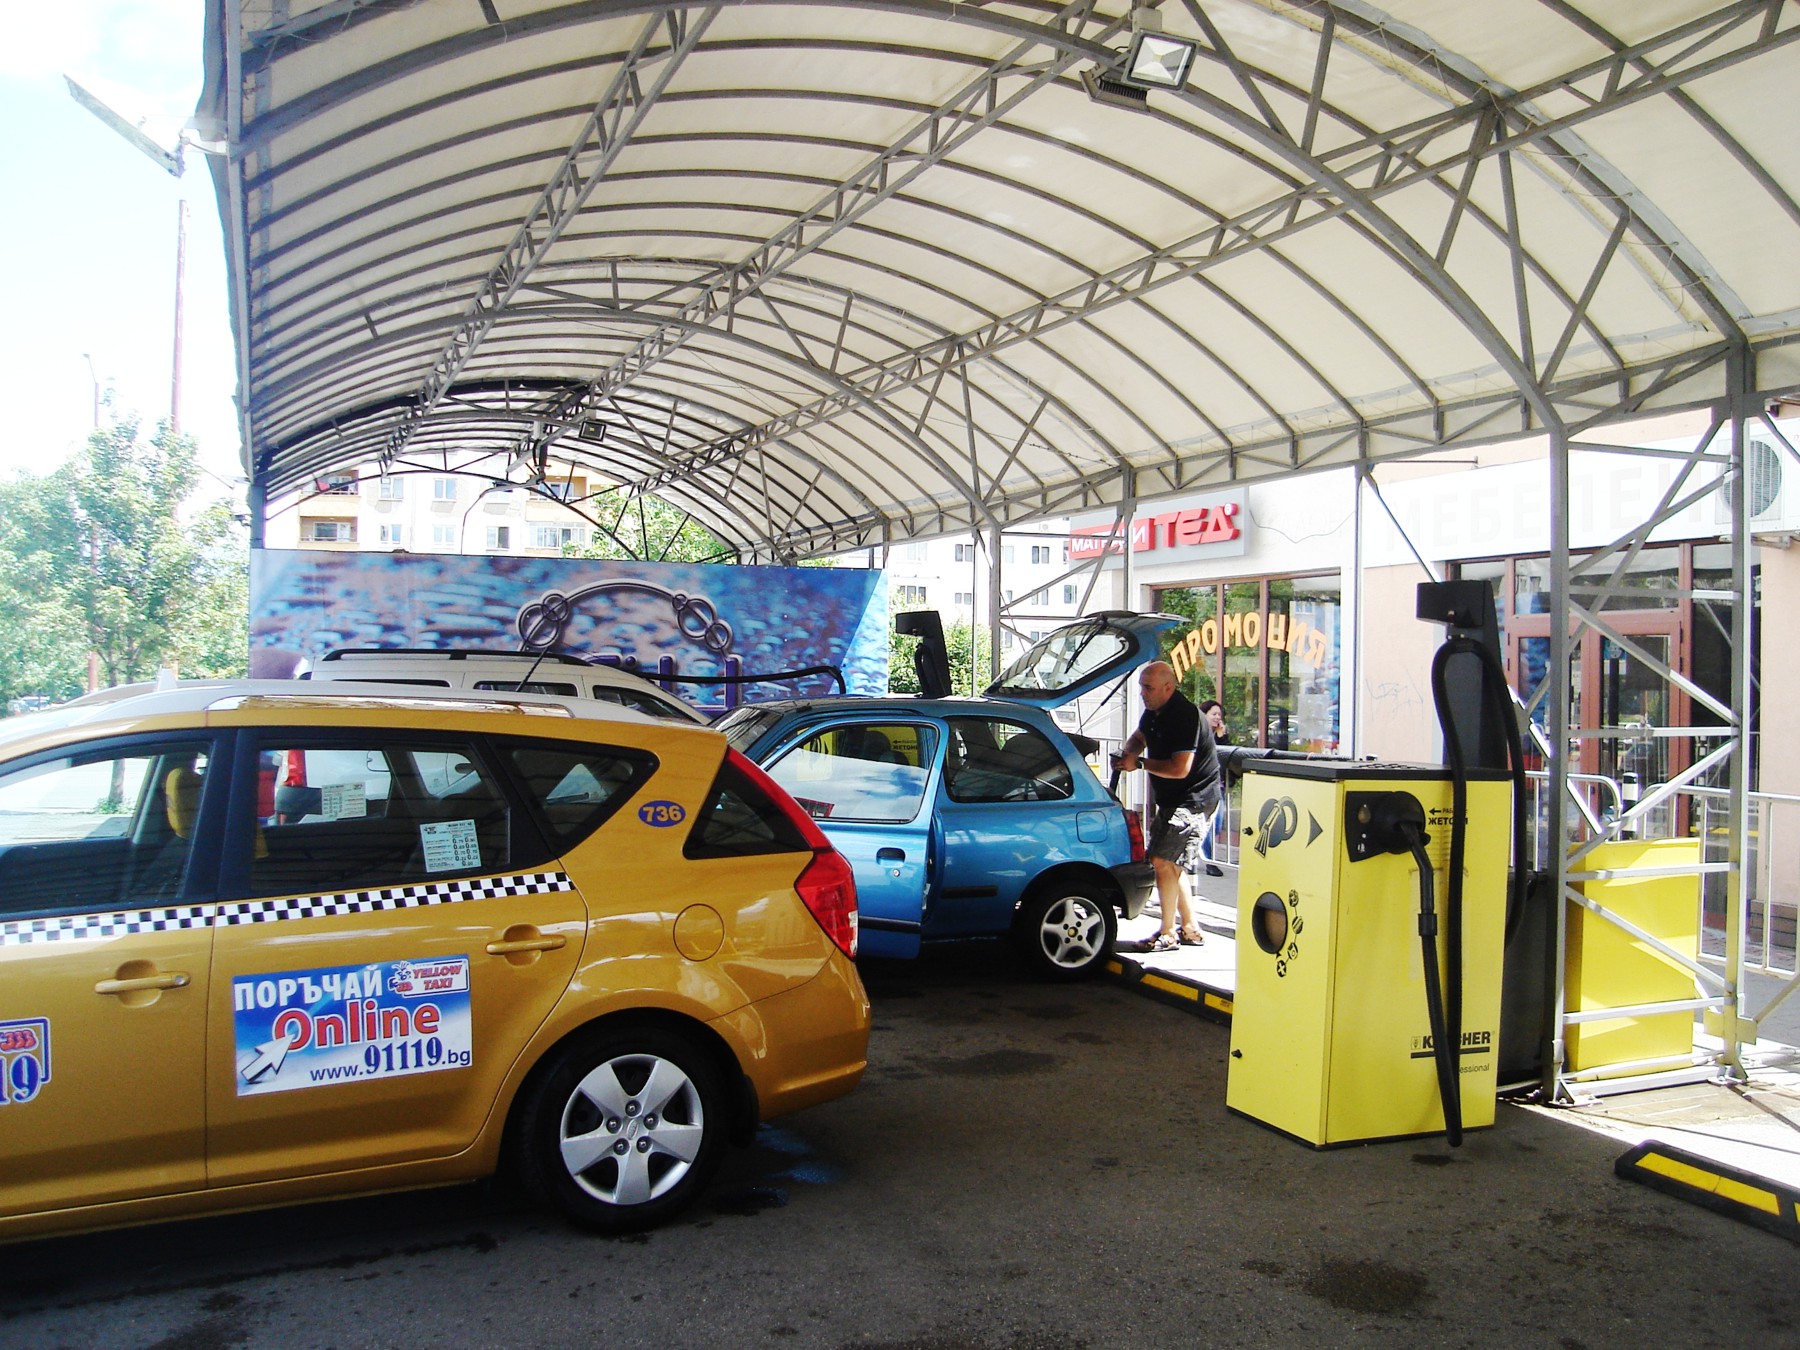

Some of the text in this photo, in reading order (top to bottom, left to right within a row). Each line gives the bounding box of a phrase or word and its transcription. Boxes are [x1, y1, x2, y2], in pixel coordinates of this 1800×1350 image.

[1153, 505, 1241, 548] ТЕД
[1170, 611, 1328, 684] ПРОМОЦИЯ
[642, 805, 682, 822] 736
[235, 965, 382, 1011] ПОРЪЧАЙ
[412, 964, 463, 979] YELLOW
[423, 977, 453, 991] TAXI
[273, 999, 440, 1050] Online
[1422, 1031, 1491, 1049] KHER
[310, 1037, 471, 1081] www.91119.bg
